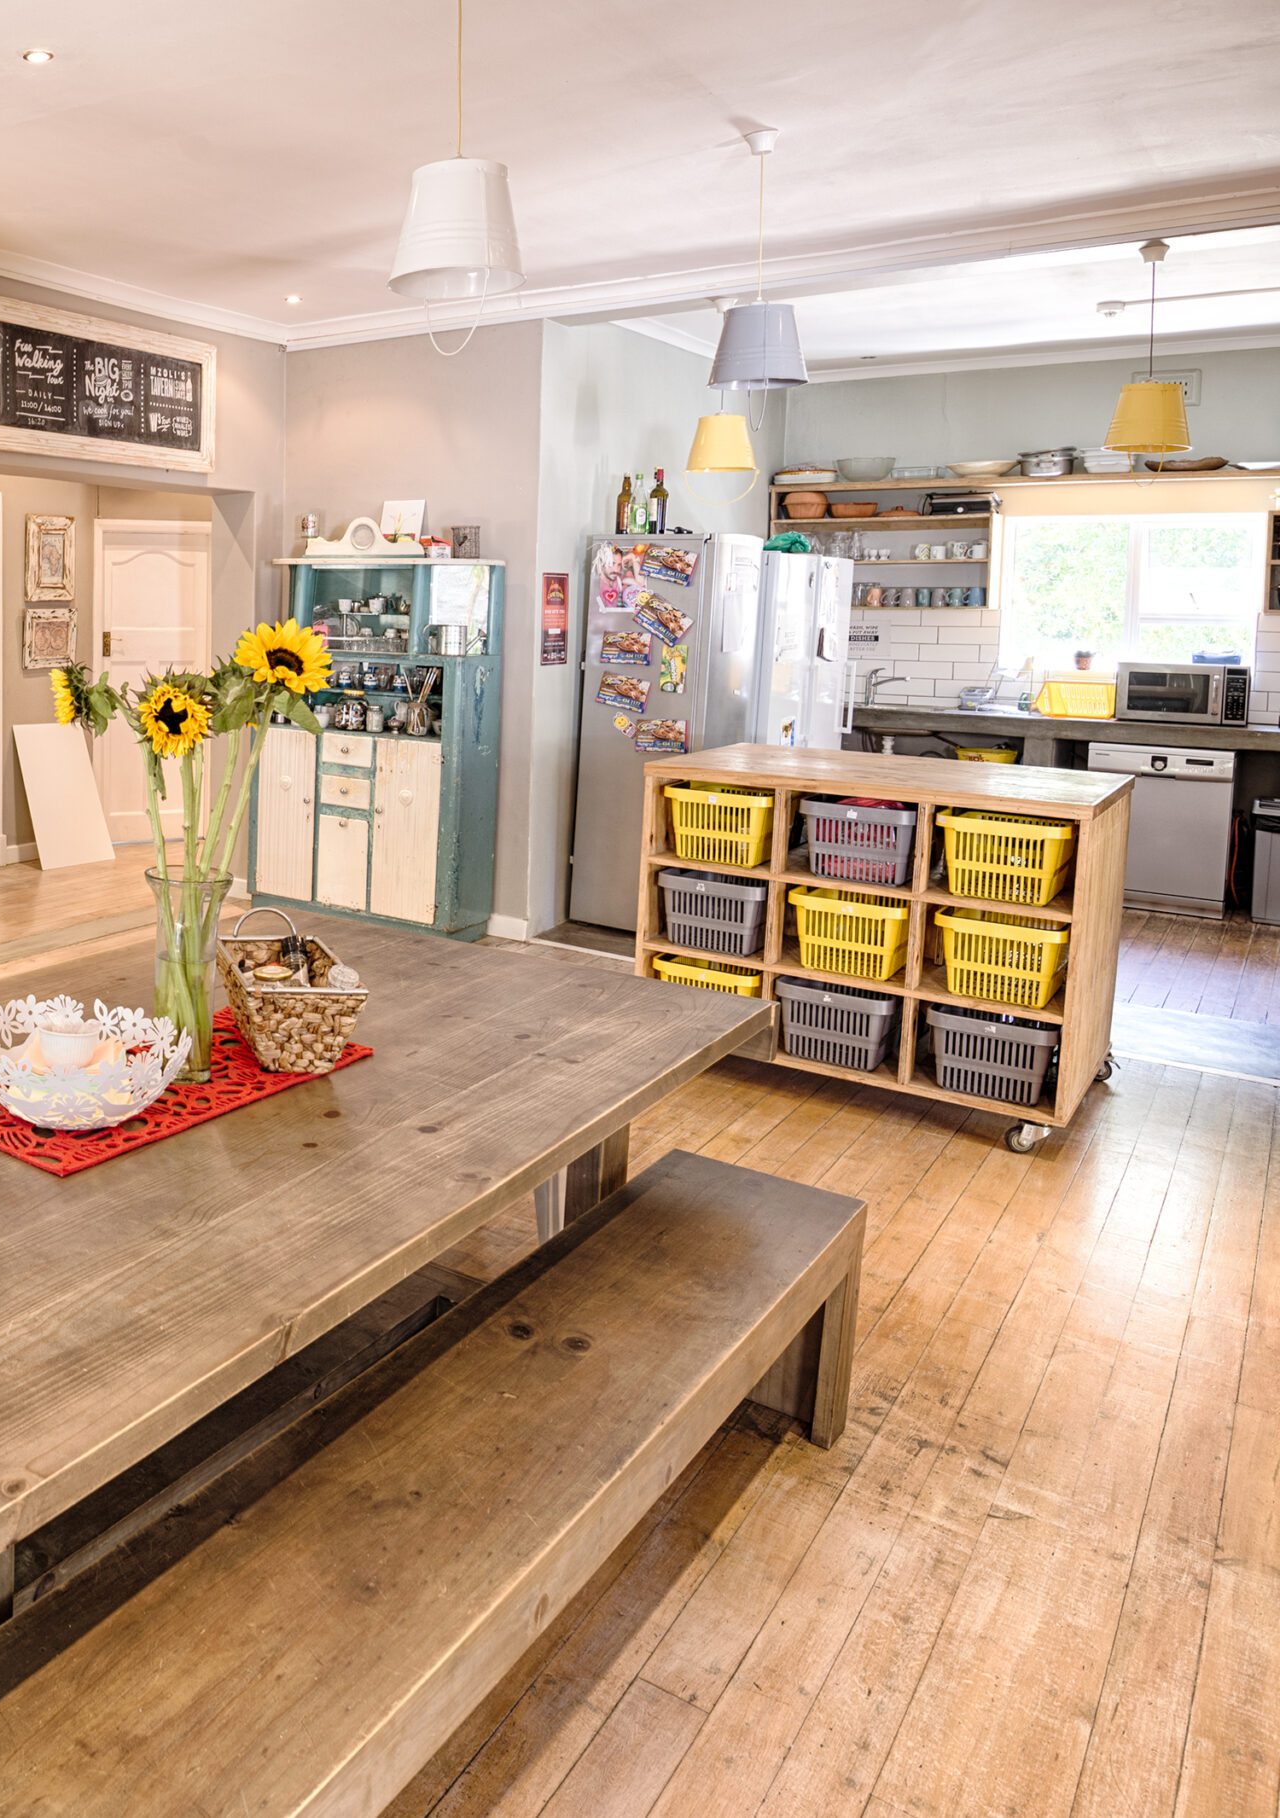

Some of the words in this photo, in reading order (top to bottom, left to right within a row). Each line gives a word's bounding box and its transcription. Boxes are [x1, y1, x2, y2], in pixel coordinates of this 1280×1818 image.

[15, 339, 32, 352] Free
[15, 352, 63, 374] Walking
[84, 360, 94, 370] The
[95, 357, 119, 379] BIG
[46, 372, 64, 384] Tour
[150, 367, 186, 380] MZOLI'S
[85, 374, 120, 404] Night
[150, 376, 173, 397] TAVERN
[28, 390, 52, 400] DAILY
[83, 406, 93, 415] We
[94, 405, 108, 415] cook
[109, 405, 119, 419] for
